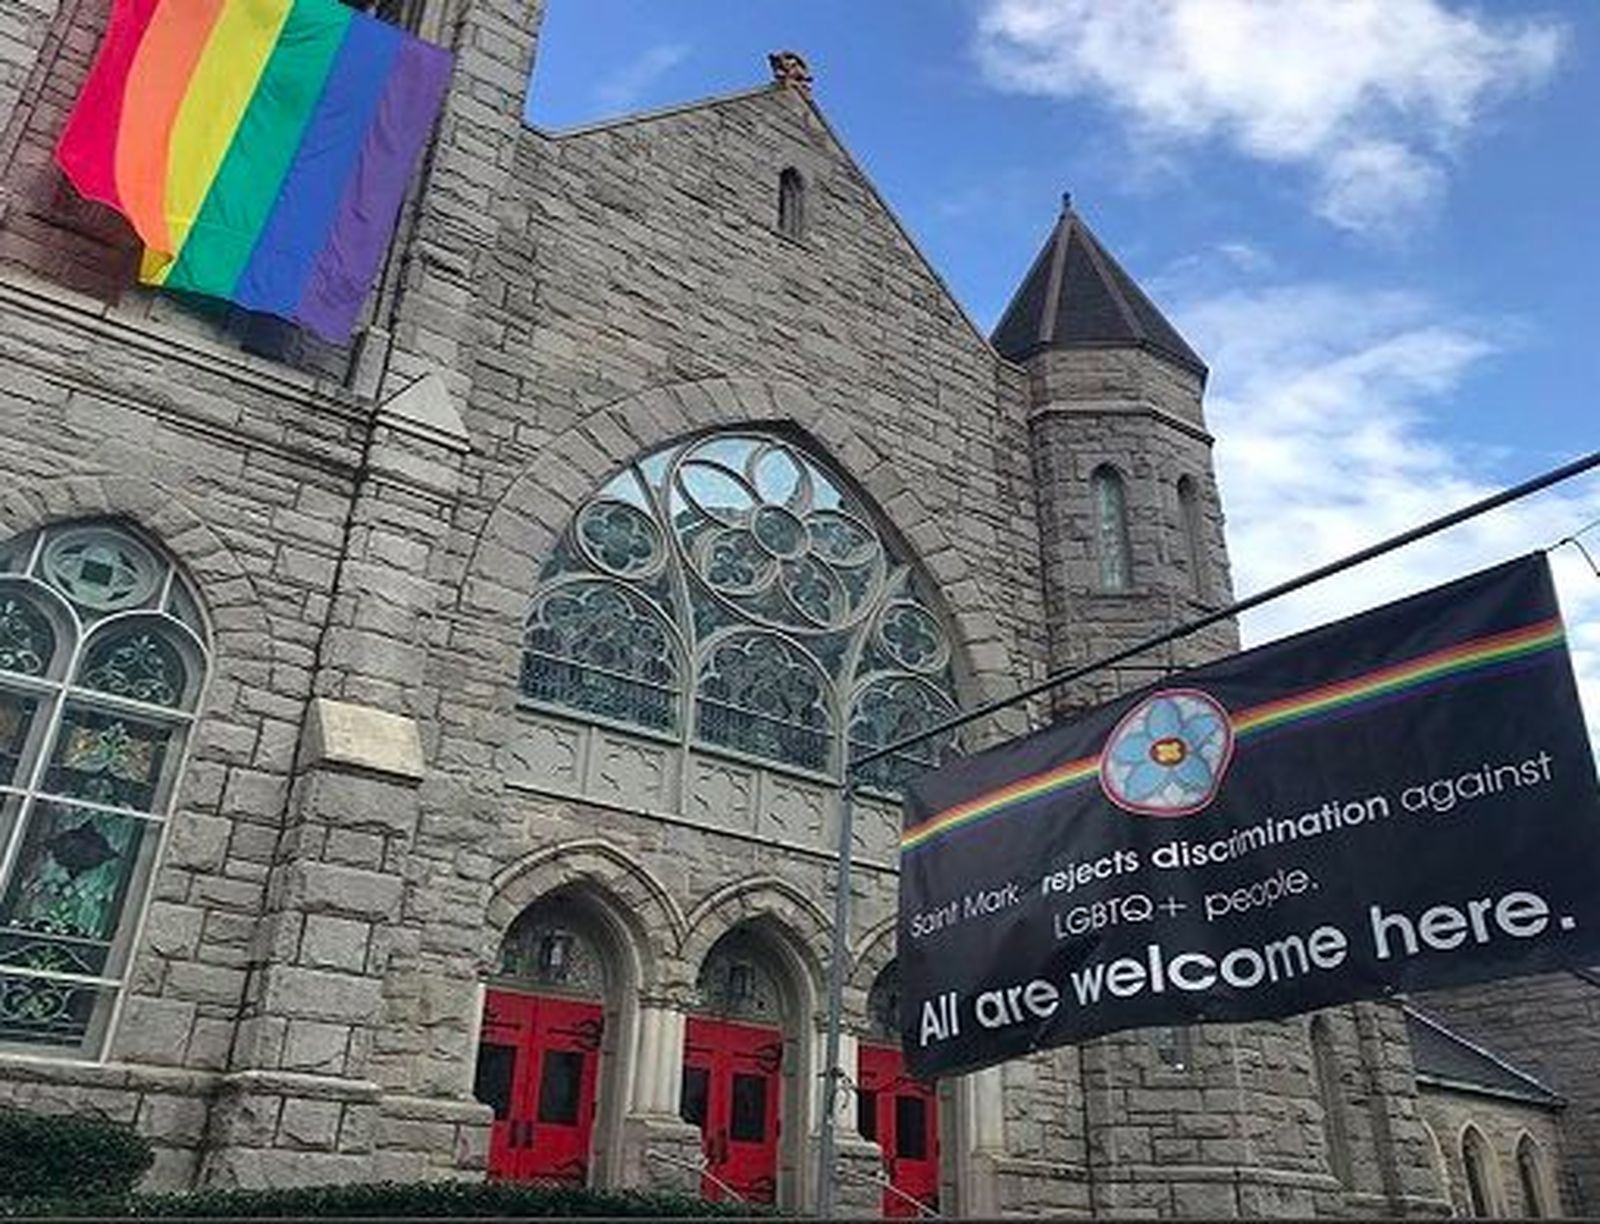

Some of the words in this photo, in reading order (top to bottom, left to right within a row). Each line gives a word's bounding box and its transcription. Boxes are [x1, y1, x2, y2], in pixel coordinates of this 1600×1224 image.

[910, 901, 958, 938] Saint
[1042, 850, 1140, 894] rejects
[1150, 795, 1390, 868] discrimination
[1400, 750, 1553, 812] against
[1054, 893, 1188, 940] LGBTQ+
[1204, 869, 1319, 921] people.
[919, 991, 960, 1047] All
[974, 979, 1060, 1029] are
[1071, 925, 1348, 1006] welcome
[1369, 891, 1576, 960] here.
